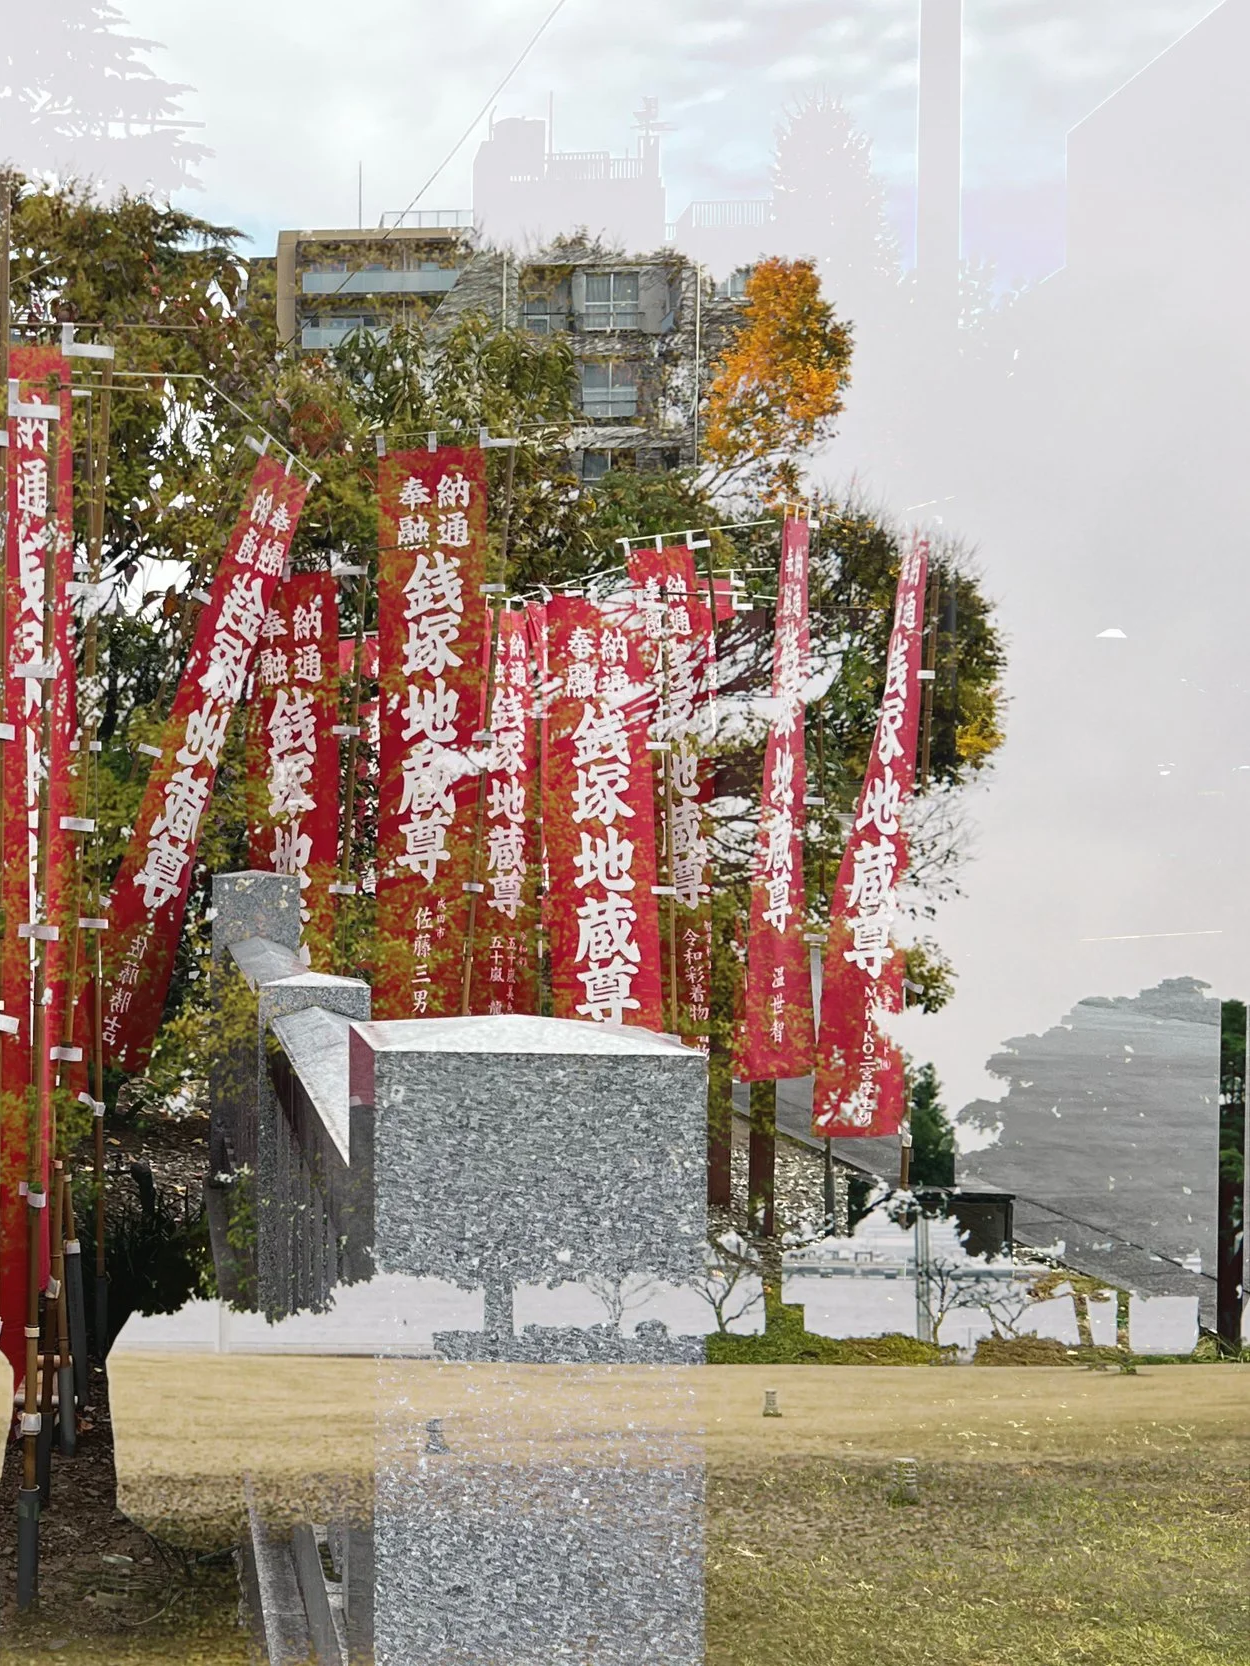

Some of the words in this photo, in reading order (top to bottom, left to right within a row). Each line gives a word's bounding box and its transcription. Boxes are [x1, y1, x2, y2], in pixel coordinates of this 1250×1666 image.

[399, 472, 471, 513] 奉納
[396, 511, 471, 553] 融通
[260, 599, 324, 645] 奉納
[567, 624, 629, 663] 奉納
[260, 643, 324, 686] 融通
[396, 550, 465, 882] 銭塚地蔵尊
[486, 685, 529, 921] 銭塚地蔵尊
[569, 701, 641, 1028] 銭塚地蔵尊
[411, 906, 434, 1014] 佐藤三男
[682, 928, 710, 1021] 令和彩着物
